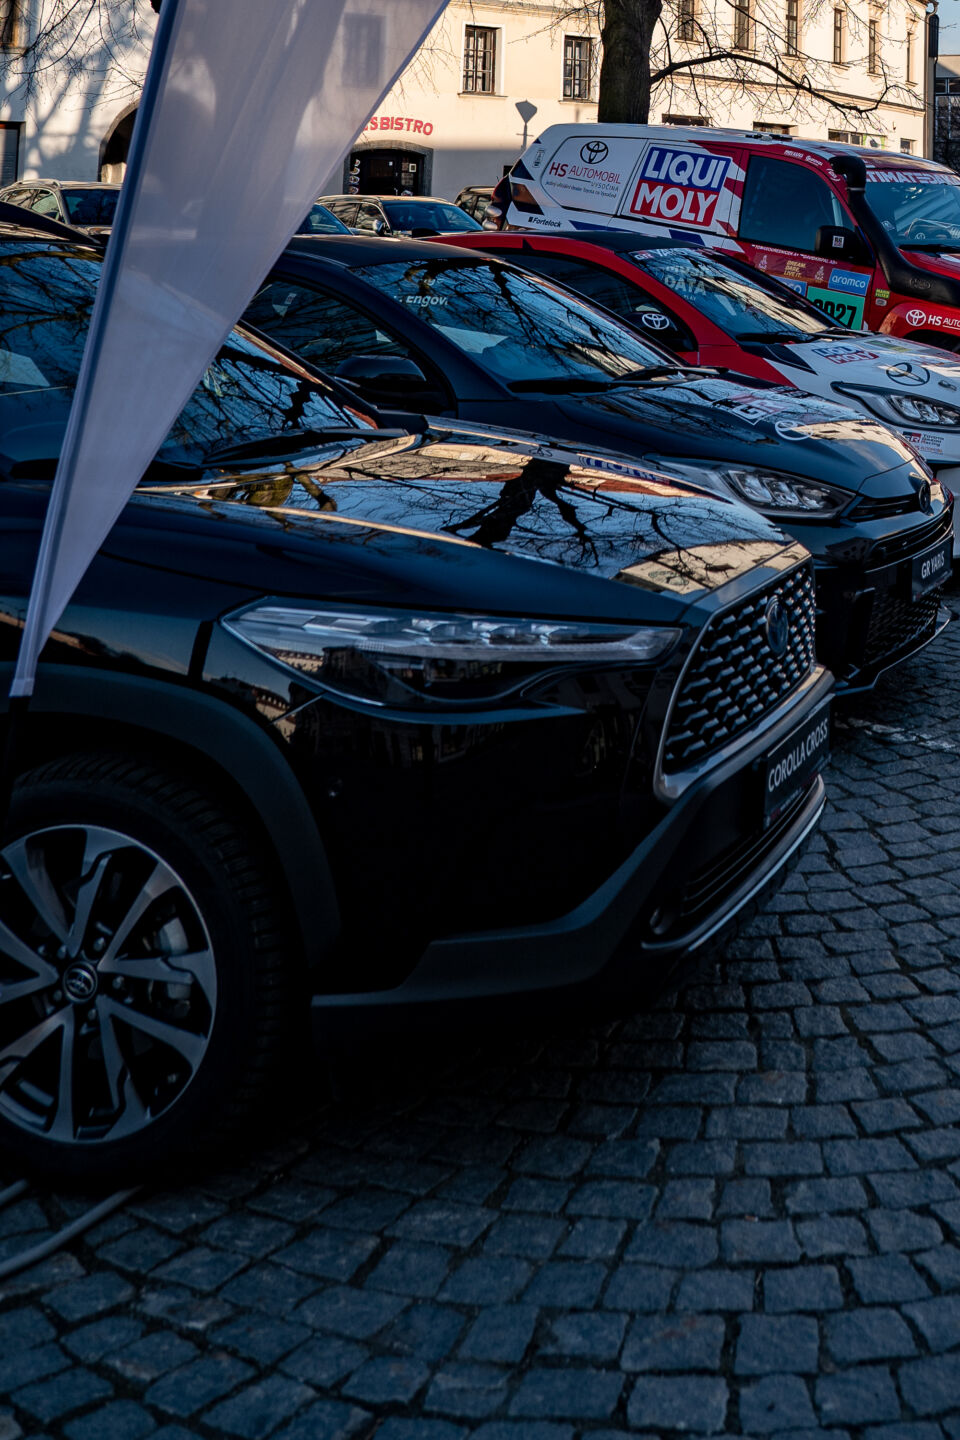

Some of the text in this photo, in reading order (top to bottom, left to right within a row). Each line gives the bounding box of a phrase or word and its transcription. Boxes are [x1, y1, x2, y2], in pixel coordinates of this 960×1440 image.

[549, 162, 621, 184] HS AUTOMOBIL
[645, 149, 726, 189] LIQUI
[634, 183, 719, 223] MOLY
[533, 218, 561, 228] Fortelock
[664, 275, 707, 296] DATA
[832, 274, 866, 289] aramco
[928, 315, 942, 326] HS
[921, 551, 944, 579] GR YARIS
[768, 718, 828, 792] COROLLA CROSS
